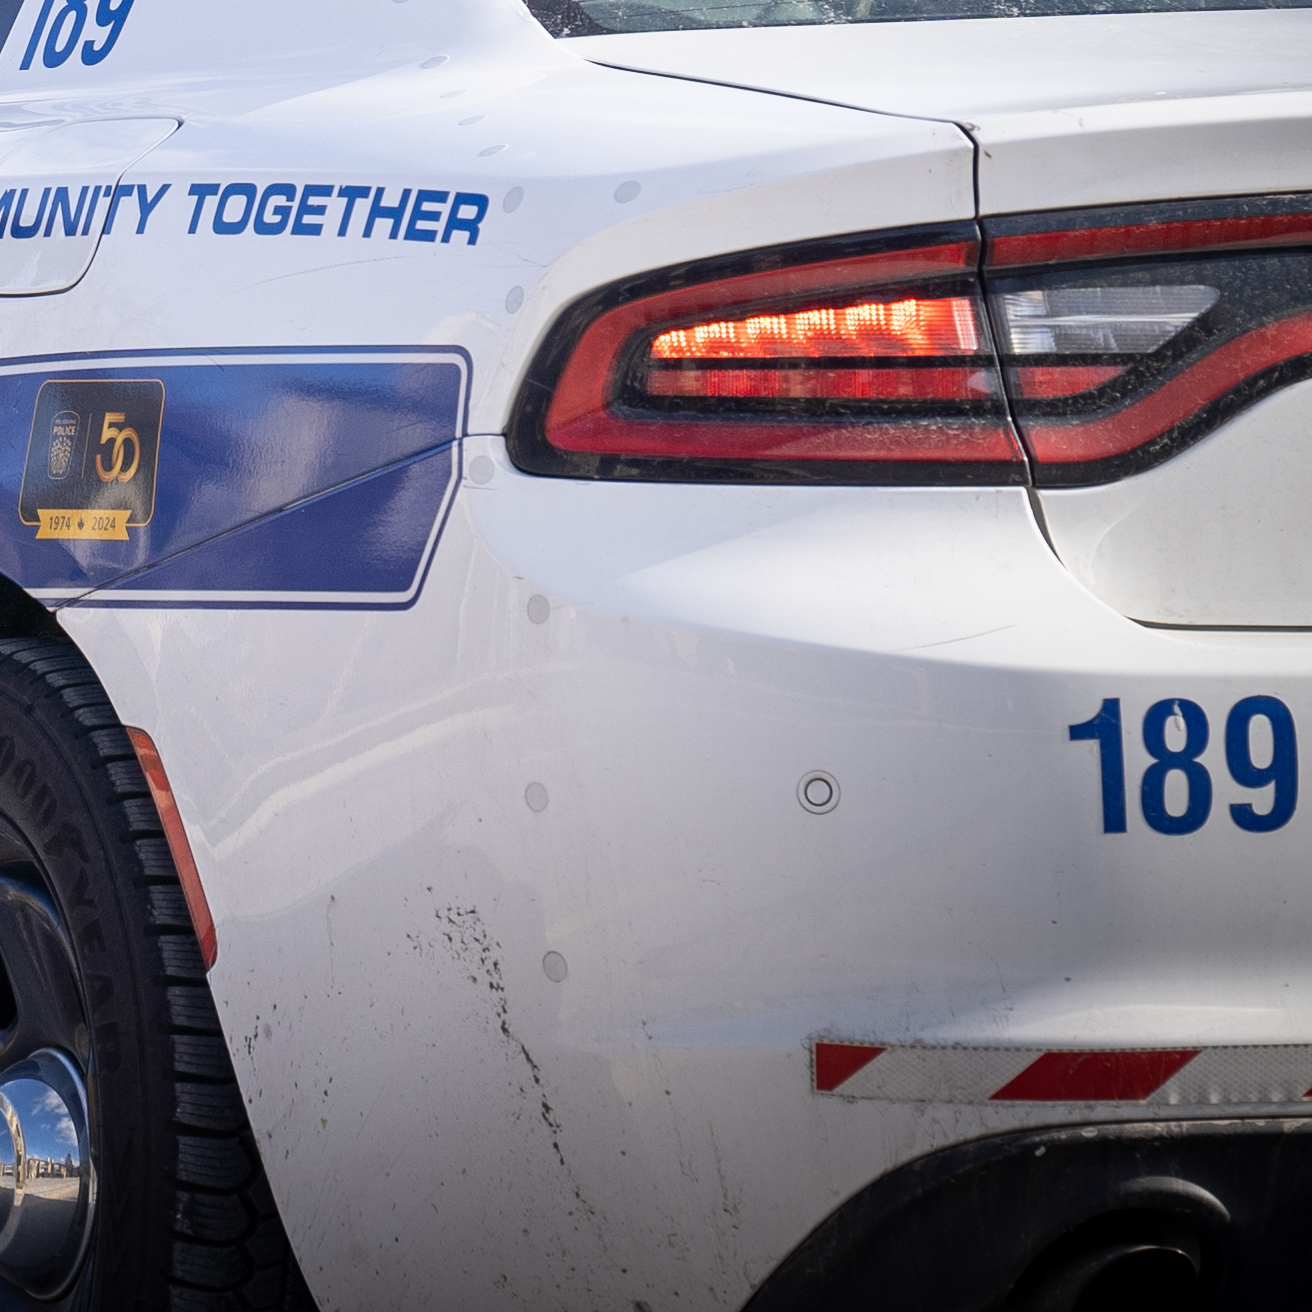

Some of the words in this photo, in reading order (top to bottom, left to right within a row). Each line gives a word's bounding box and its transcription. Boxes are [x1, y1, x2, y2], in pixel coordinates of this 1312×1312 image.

[187, 183, 490, 246] TOGETHER
[52, 425, 77, 436] POLICE
[95, 412, 141, 482] 50
[49, 516, 71, 531] 1974
[92, 517, 116, 531] 2024
[1068, 695, 1299, 835] 189
